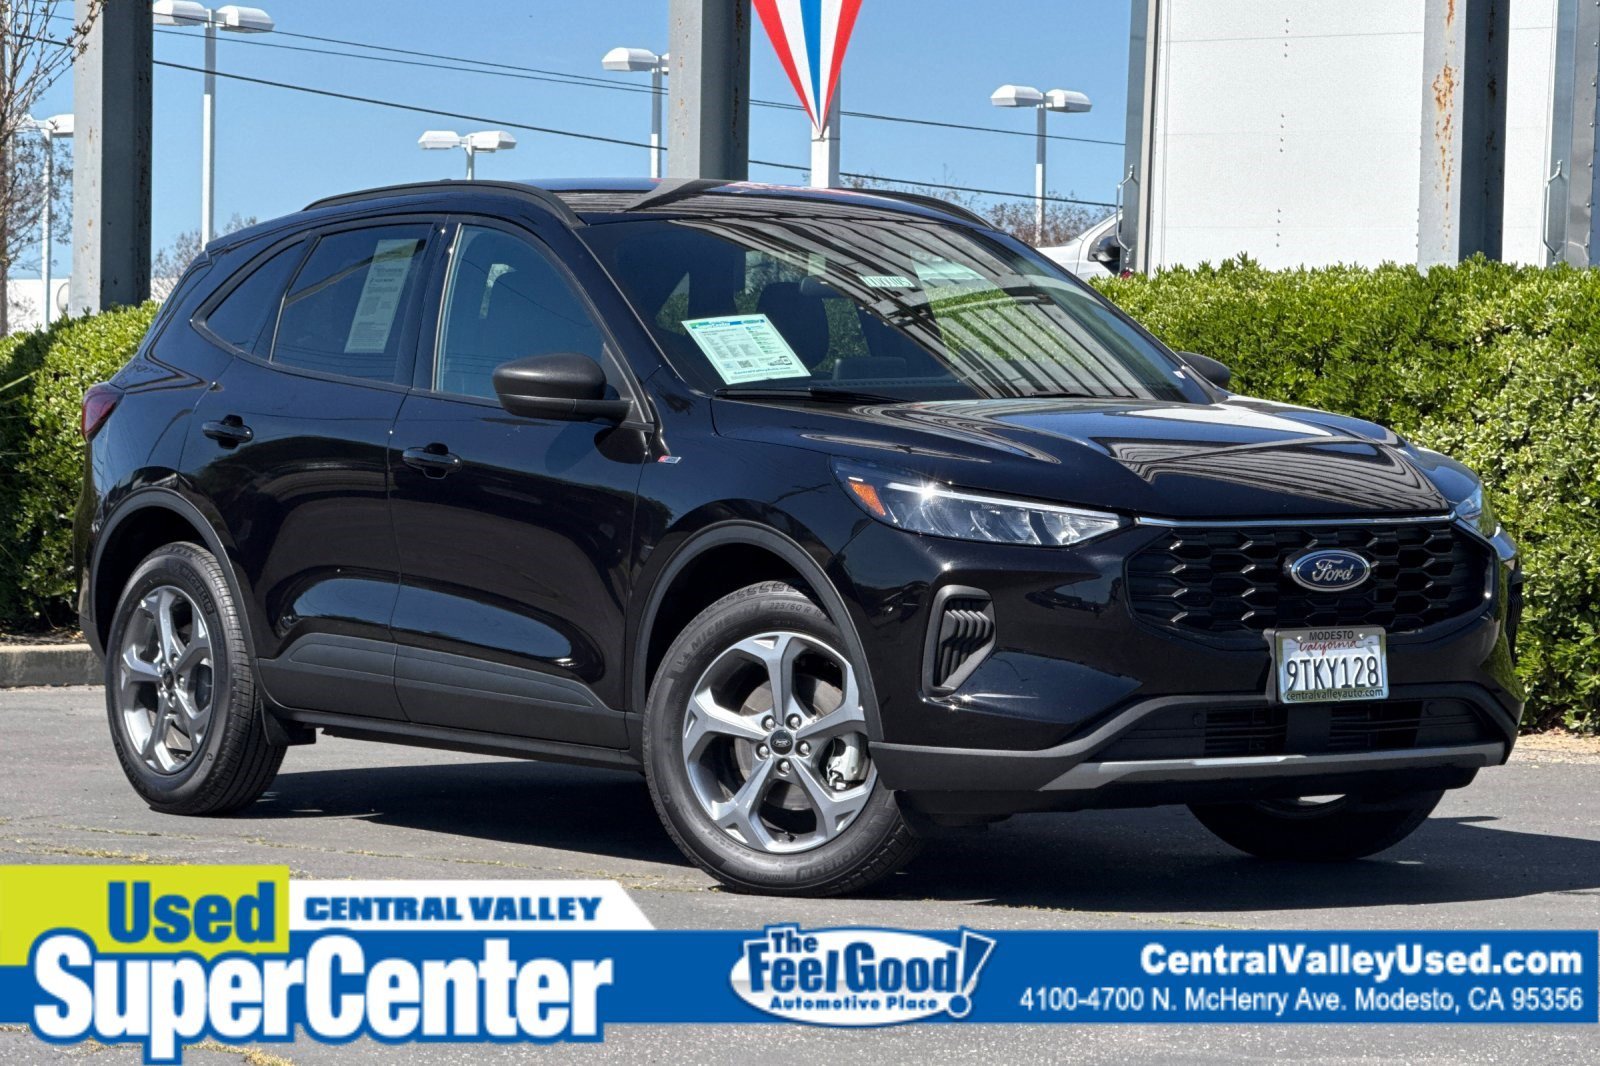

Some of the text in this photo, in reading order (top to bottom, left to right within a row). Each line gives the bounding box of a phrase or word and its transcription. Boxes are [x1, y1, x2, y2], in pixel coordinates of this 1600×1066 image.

[1312, 558, 1354, 582] Ford
[1309, 630, 1354, 641] MODESTO
[1299, 640, 1358, 656] California
[1286, 656, 1380, 691] 9TKY128
[1286, 687, 1384, 701] centralvalleyauto.com
